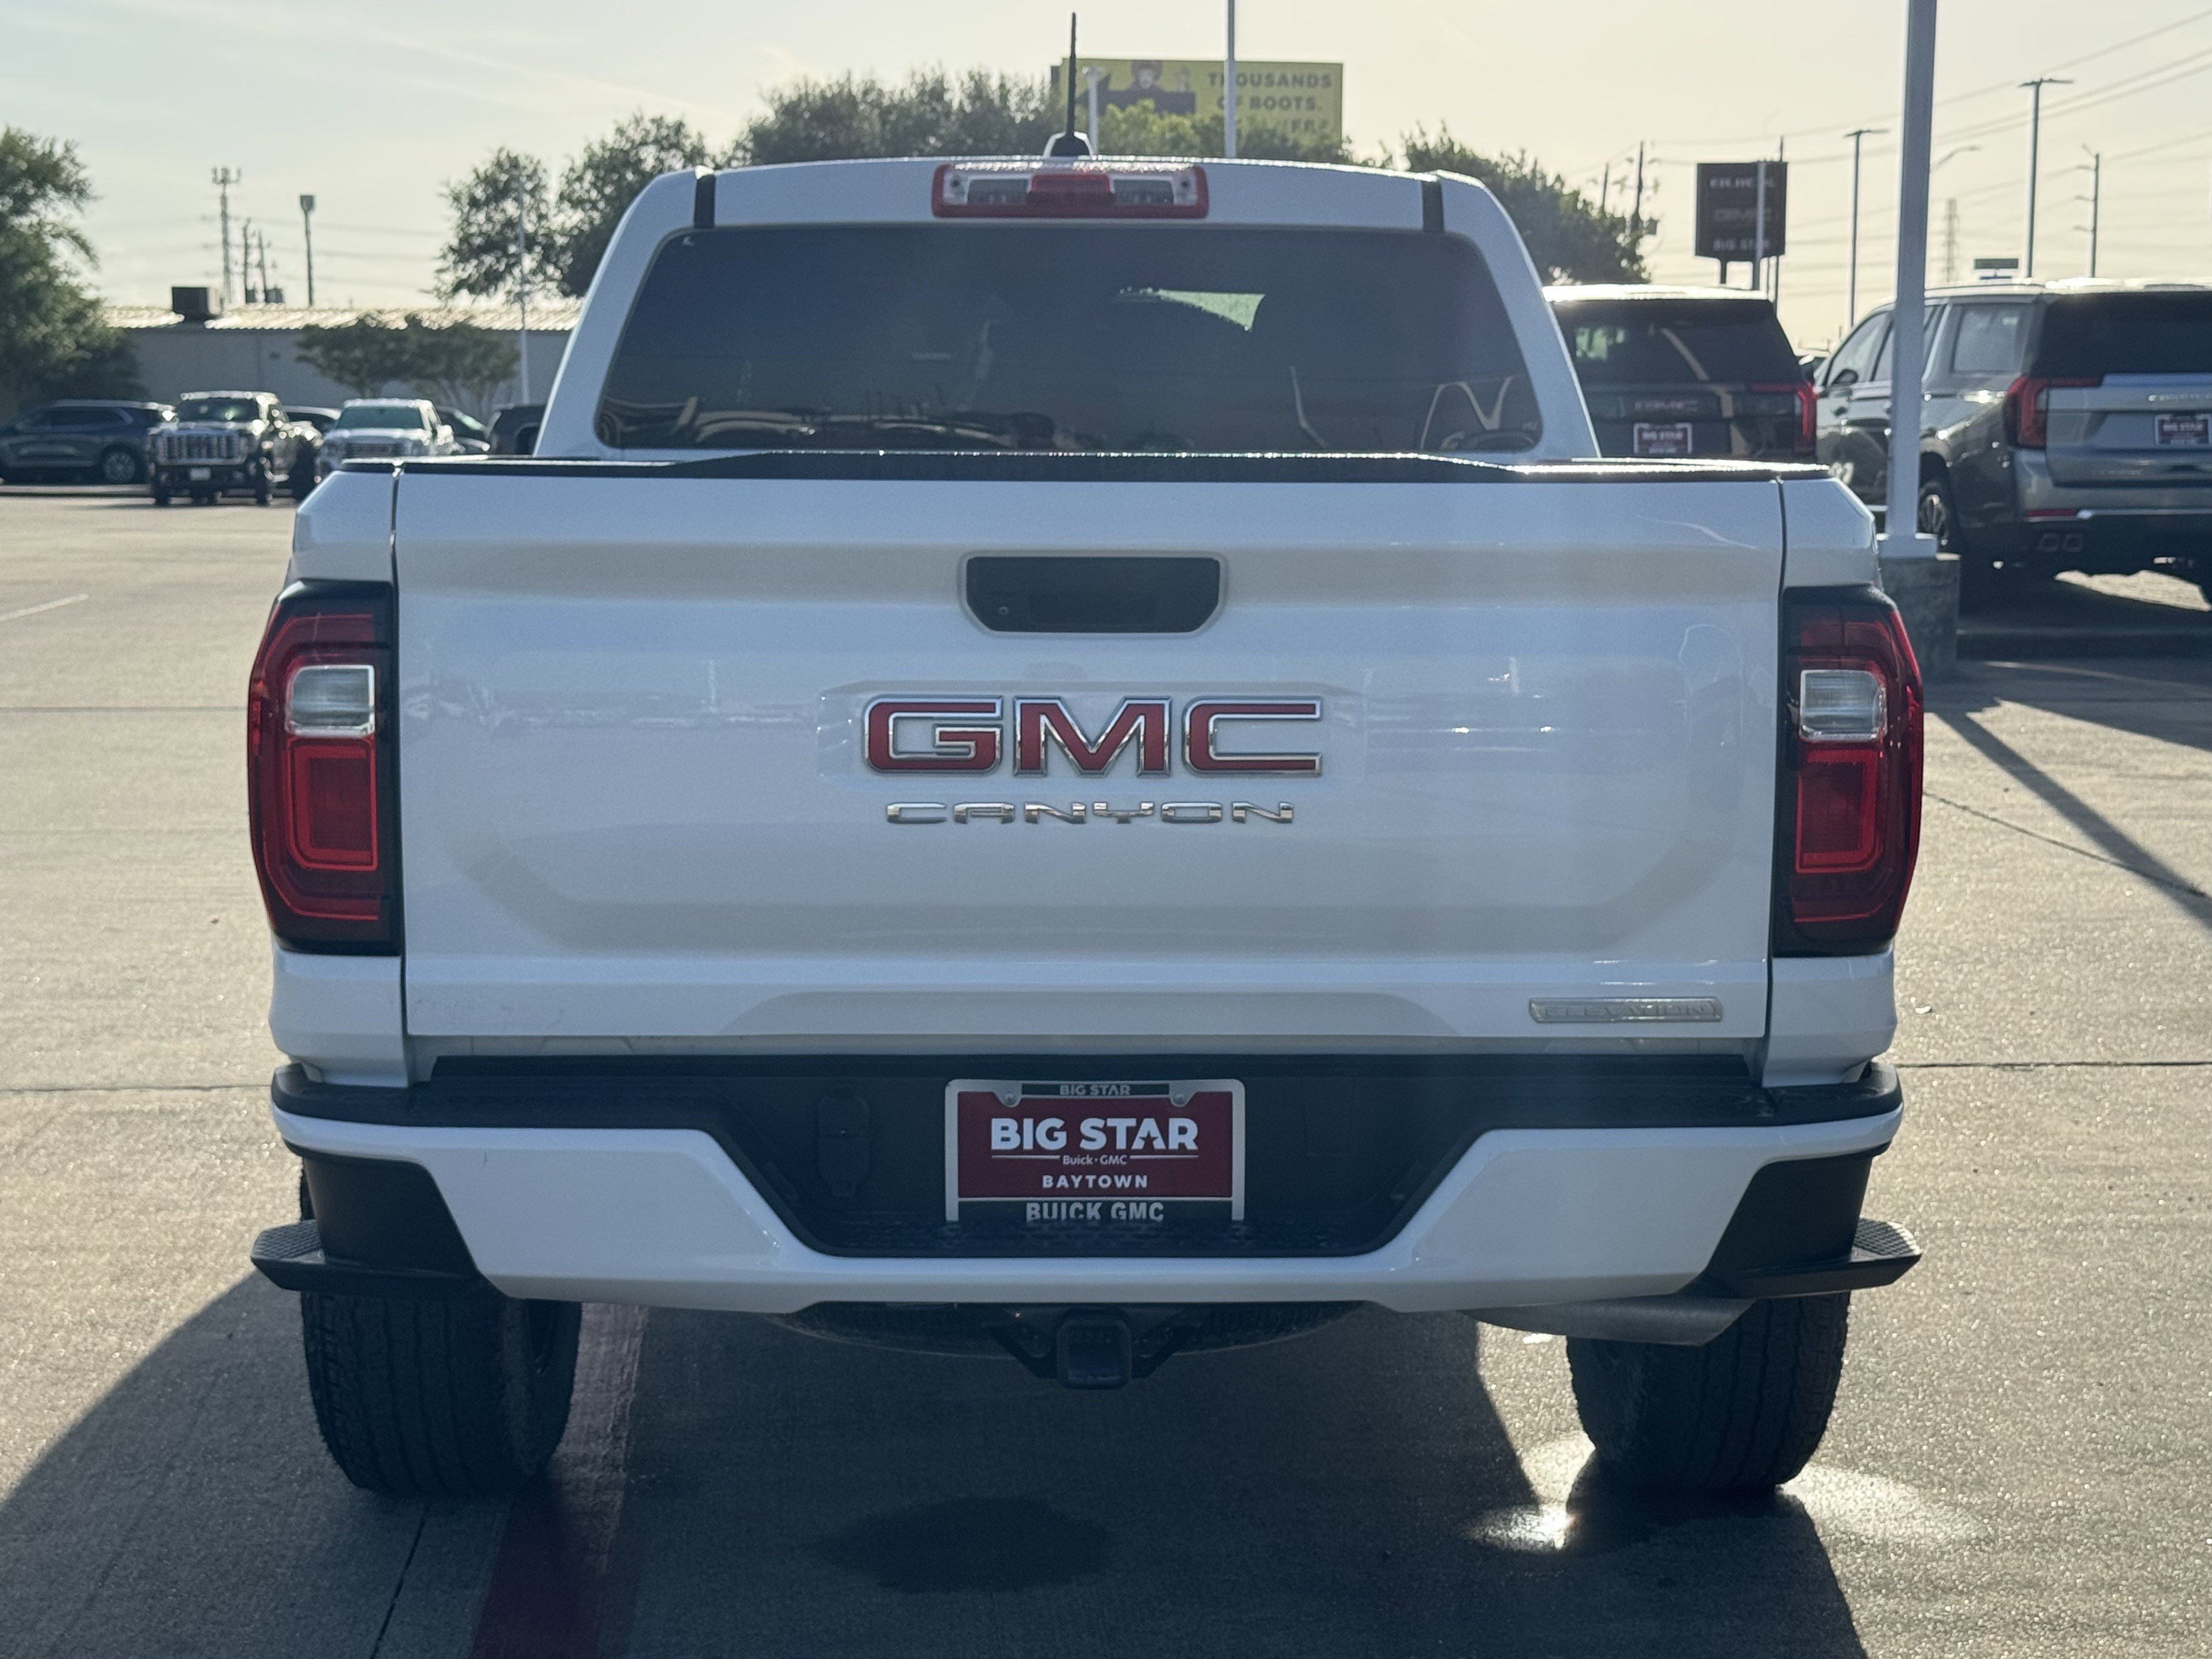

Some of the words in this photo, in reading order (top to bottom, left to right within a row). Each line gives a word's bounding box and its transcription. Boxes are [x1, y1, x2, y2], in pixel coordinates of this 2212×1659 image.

[864, 695, 1322, 777] GMC
[885, 801, 1295, 825] CANYON
[1543, 1001, 1717, 1019] ELEVATION
[1059, 1084, 1086, 1096] BIG
[1090, 1084, 1131, 1096] STAR
[991, 1118, 1068, 1150] BIG
[1079, 1118, 1199, 1150] STAR
[1042, 1175, 1148, 1189] BAYTOWN
[1026, 1202, 1103, 1221] BUICK
[1111, 1202, 1165, 1221] GMC
